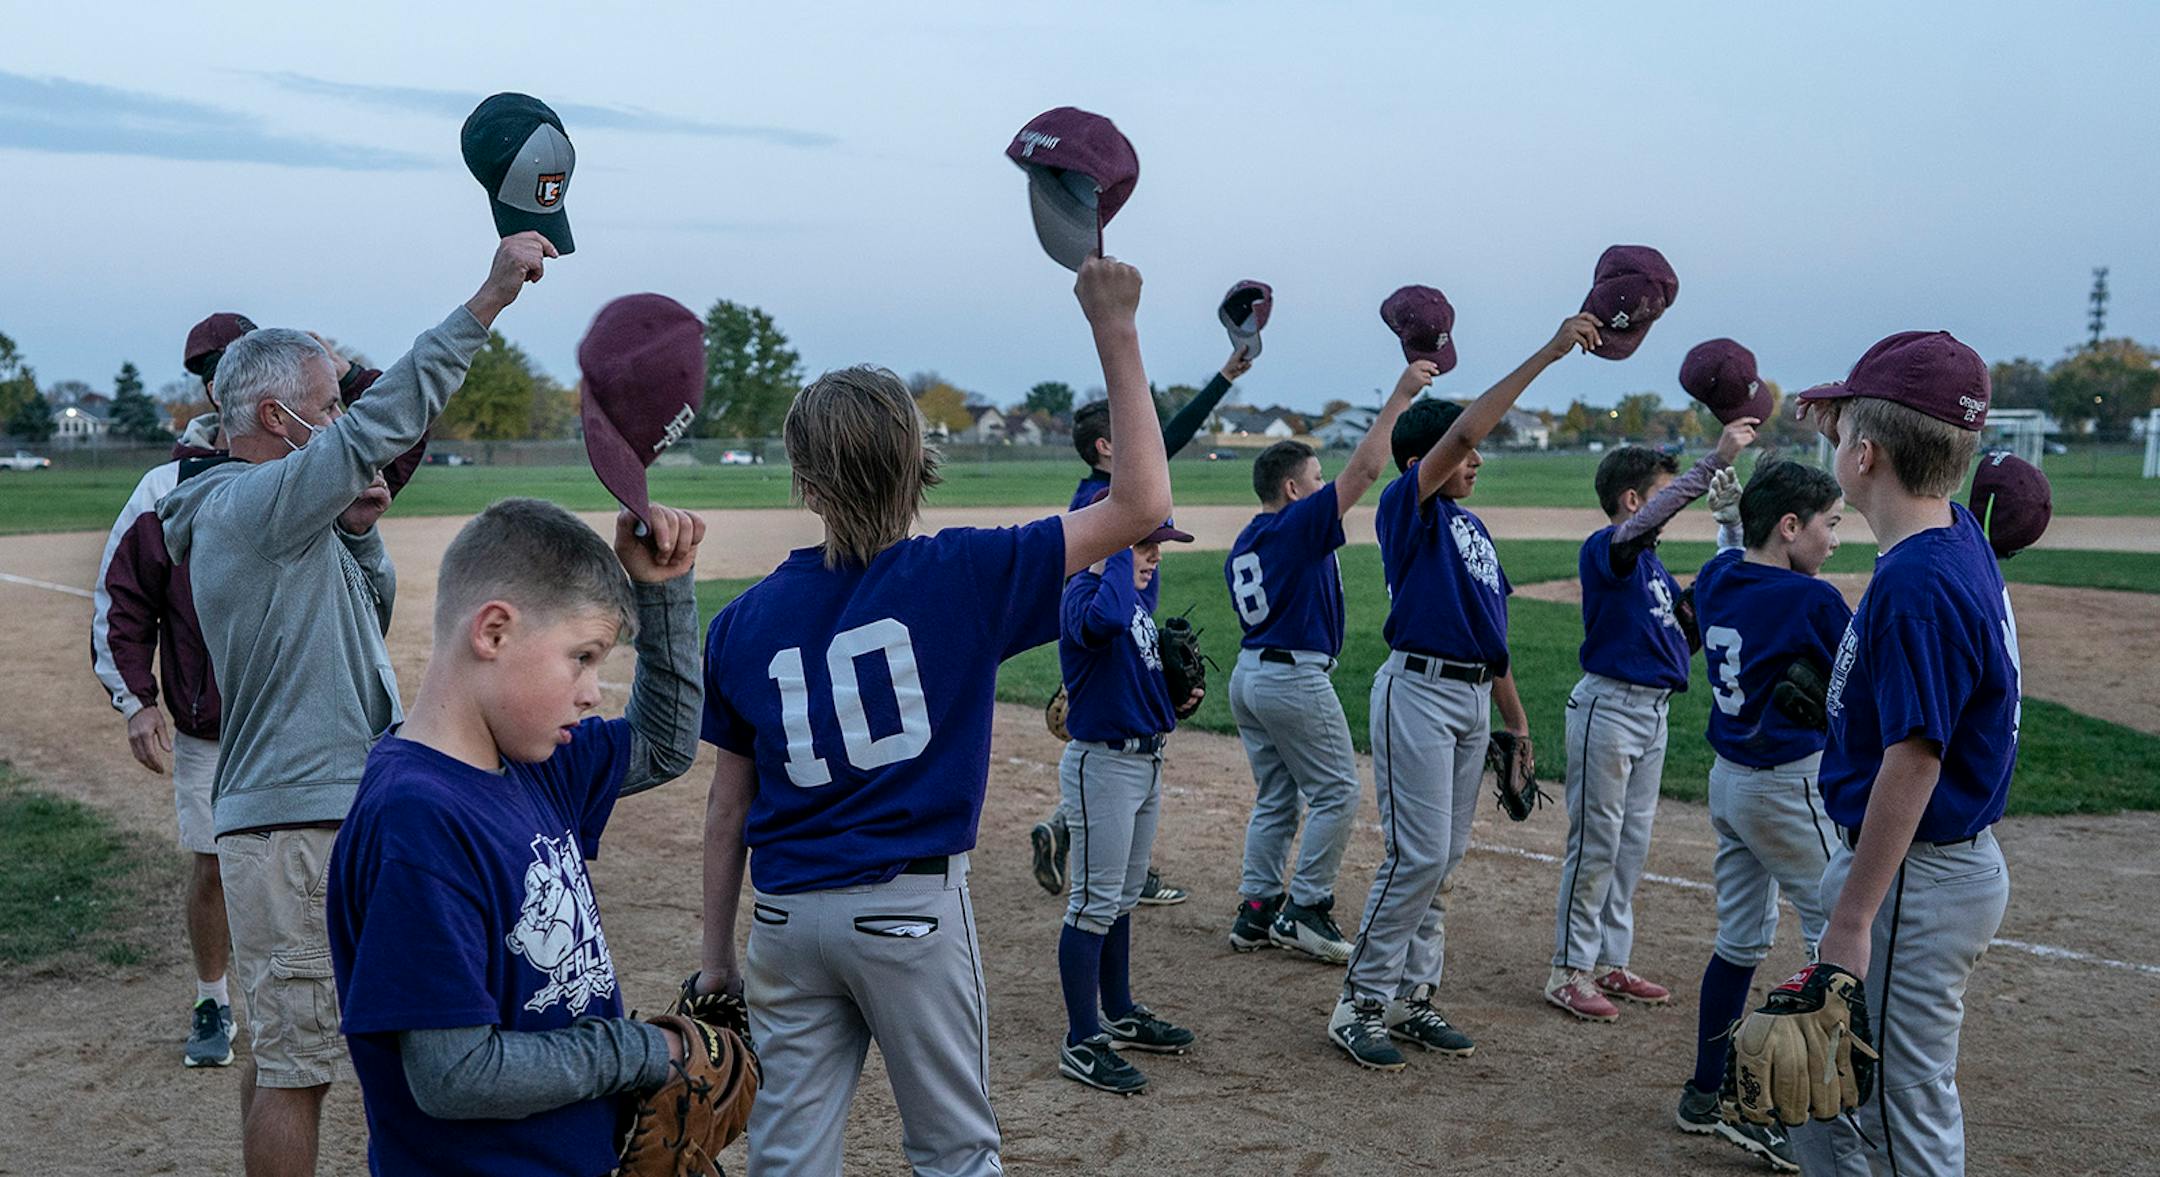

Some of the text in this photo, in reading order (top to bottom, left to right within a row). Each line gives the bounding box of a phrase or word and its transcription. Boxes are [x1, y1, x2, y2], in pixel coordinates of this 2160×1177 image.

[1232, 552, 1270, 626] 8
[768, 617, 932, 788] 10
[1705, 625, 1745, 716] 3
